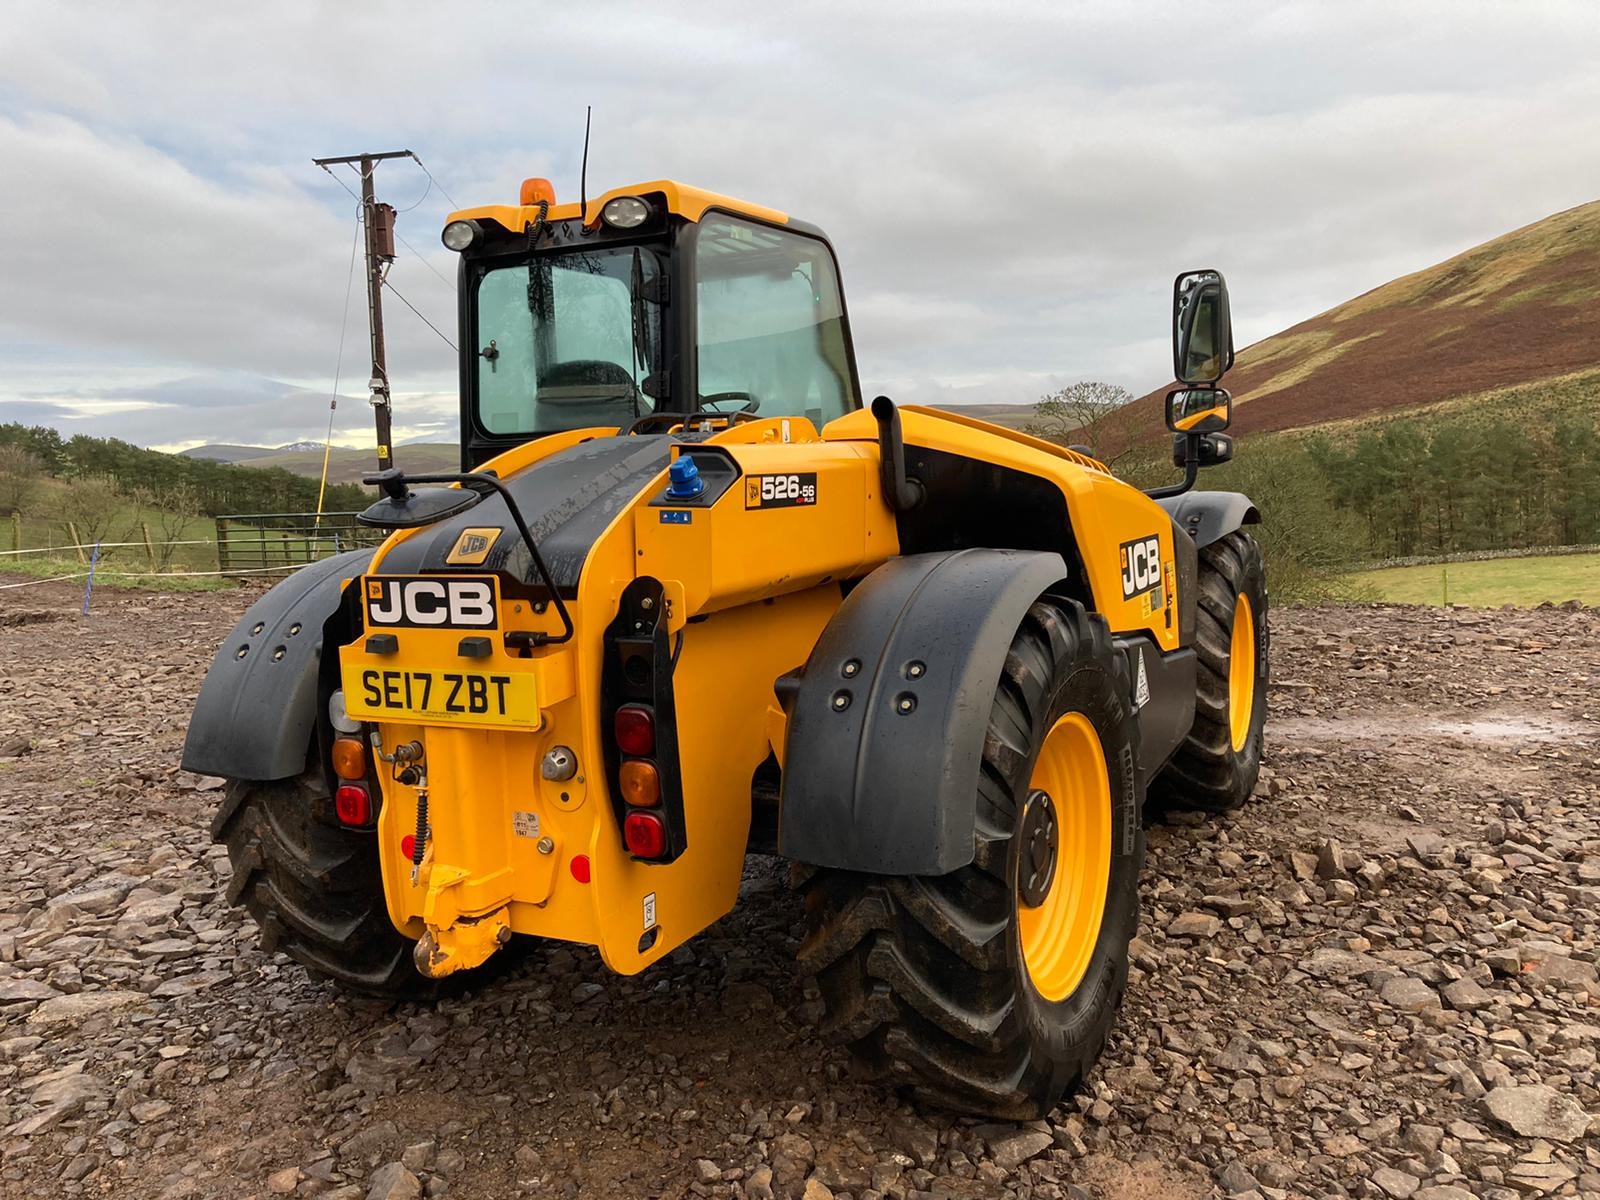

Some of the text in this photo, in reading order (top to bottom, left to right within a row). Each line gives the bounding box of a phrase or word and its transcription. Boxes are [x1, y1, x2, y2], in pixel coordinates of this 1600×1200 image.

[762, 475, 815, 500] 526-56
[463, 534, 488, 552] JCB
[1123, 539, 1161, 595] JCB
[370, 581, 495, 625] JCB
[362, 670, 511, 715] SE17 ZBT
